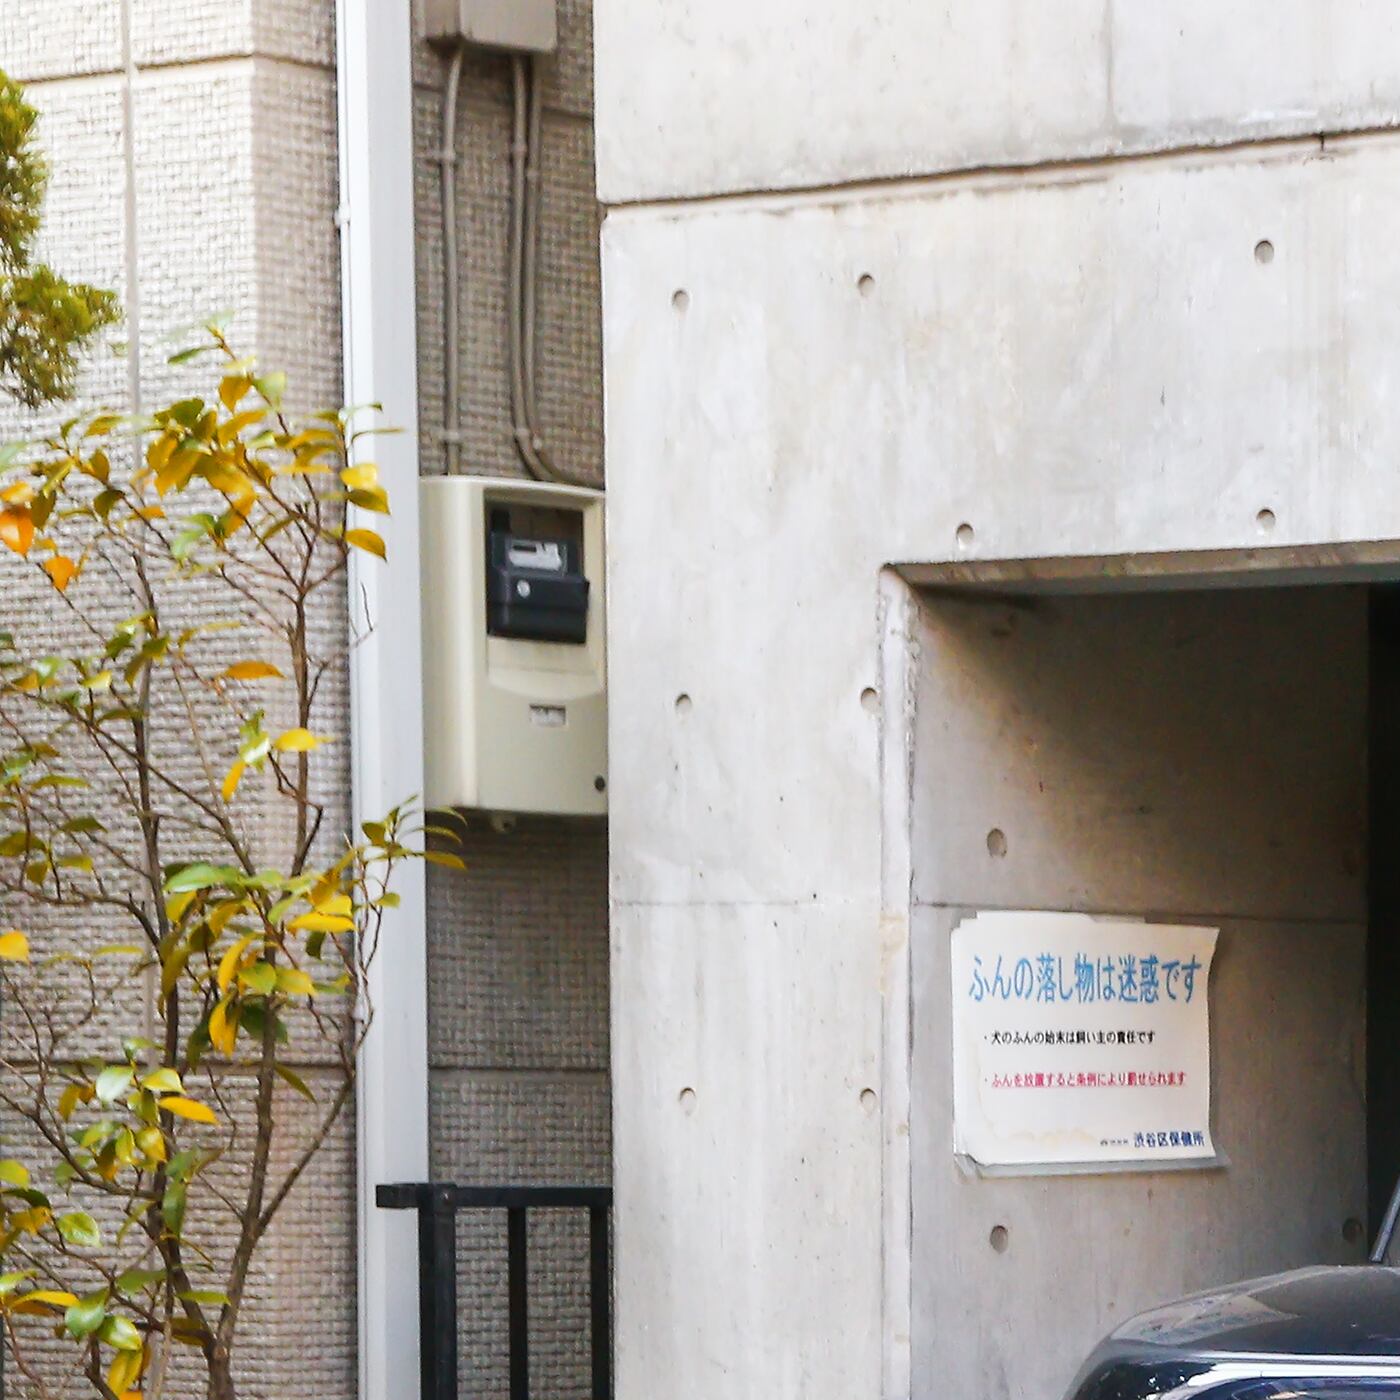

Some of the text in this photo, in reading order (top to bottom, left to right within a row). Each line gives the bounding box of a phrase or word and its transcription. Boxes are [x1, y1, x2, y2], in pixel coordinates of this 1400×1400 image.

[968, 952, 1203, 1003] ふんの落し物は迷惑です
